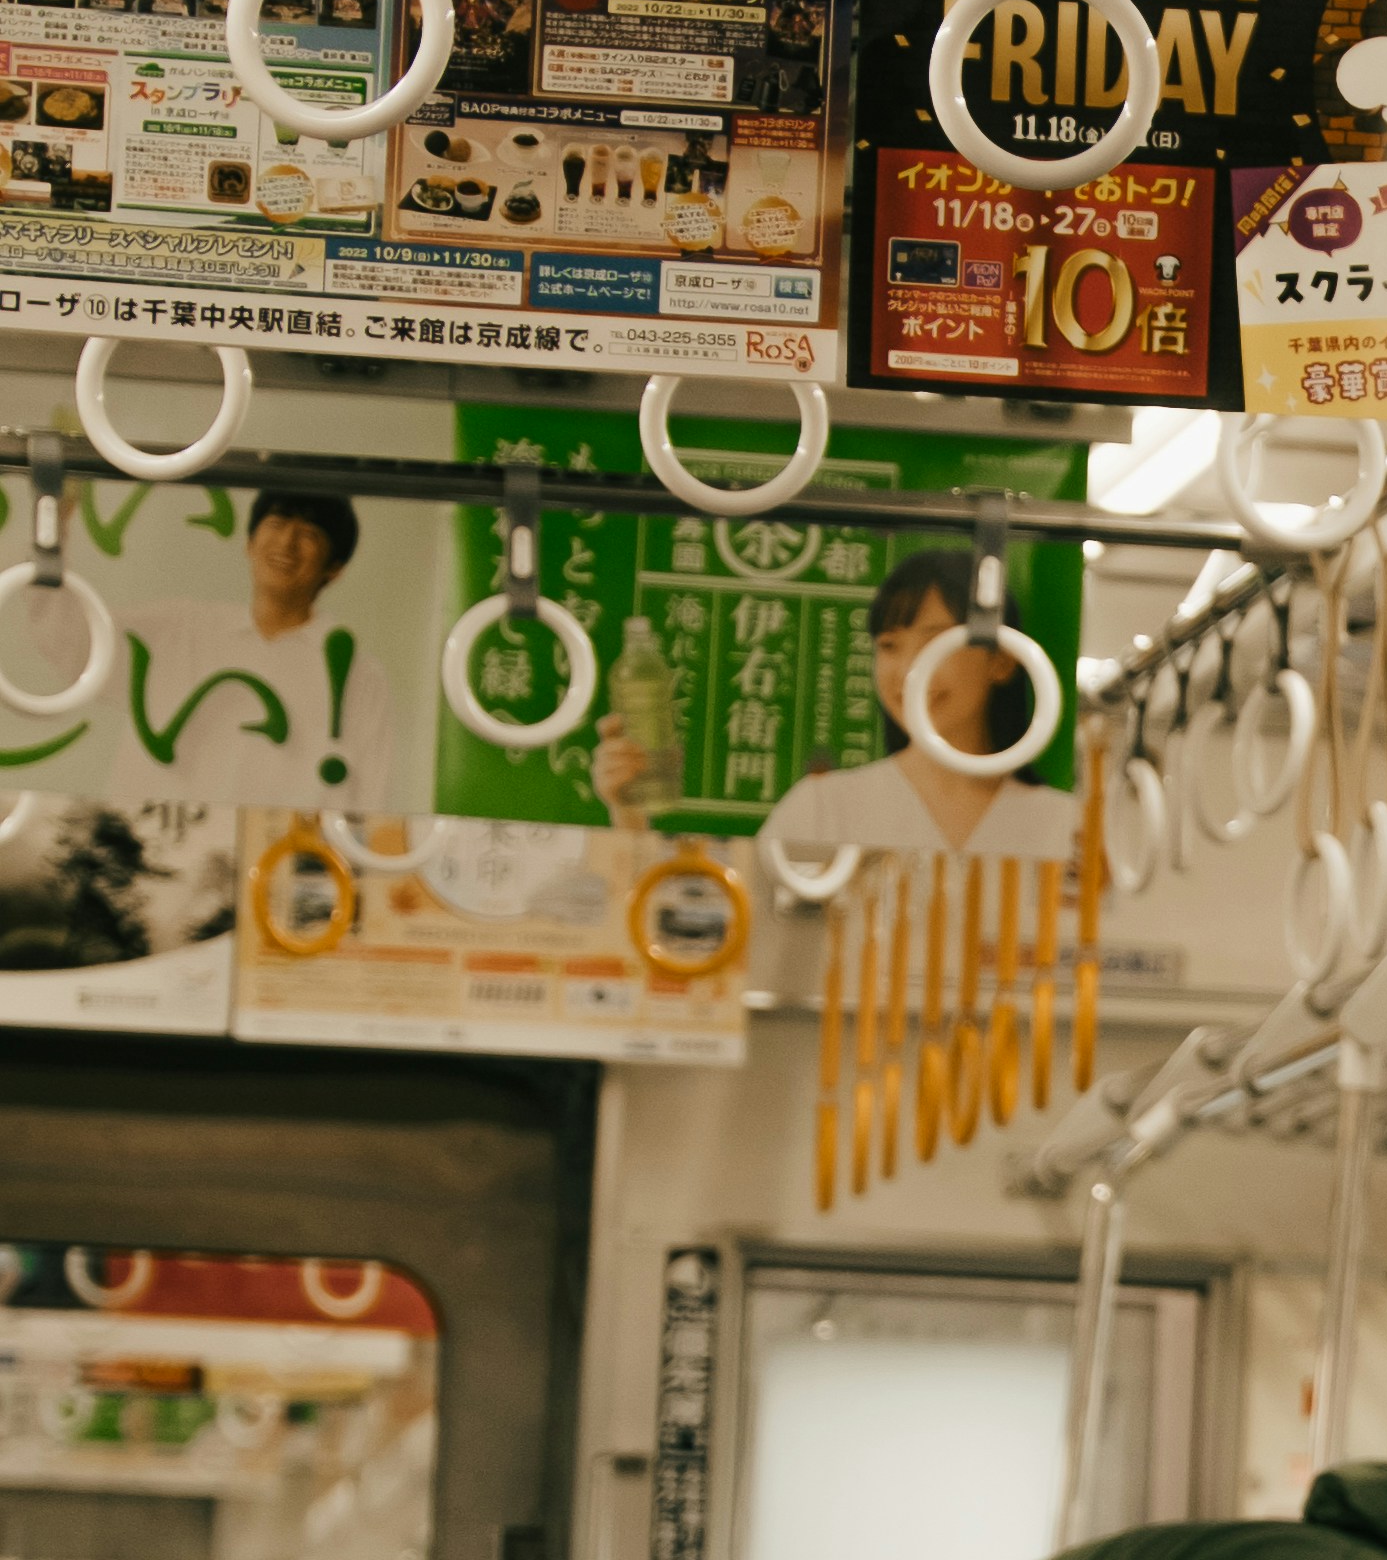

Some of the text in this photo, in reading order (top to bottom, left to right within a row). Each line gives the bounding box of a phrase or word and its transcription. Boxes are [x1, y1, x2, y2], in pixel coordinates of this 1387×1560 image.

[1012, 113, 1105, 144] 11.18(金)
[897, 161, 1197, 207] イオンカでおトク!
[1236, 166, 1301, 237] 同時開催!
[1304, 205, 1345, 222] 専門店
[1311, 222, 1341, 238] 限定
[338, 246, 368, 258] 2022
[537, 282, 652, 301] 公式ホームページで!
[668, 296, 811, 317] http://www.rosa10.net
[0, 288, 604, 354] ローザ⑩は千葉中央駅直結。ご来館は京成線で。
[901, 316, 985, 342] ポイント
[626, 327, 738, 347] 043-225-6355
[726, 595, 790, 800] 伊右衛門
